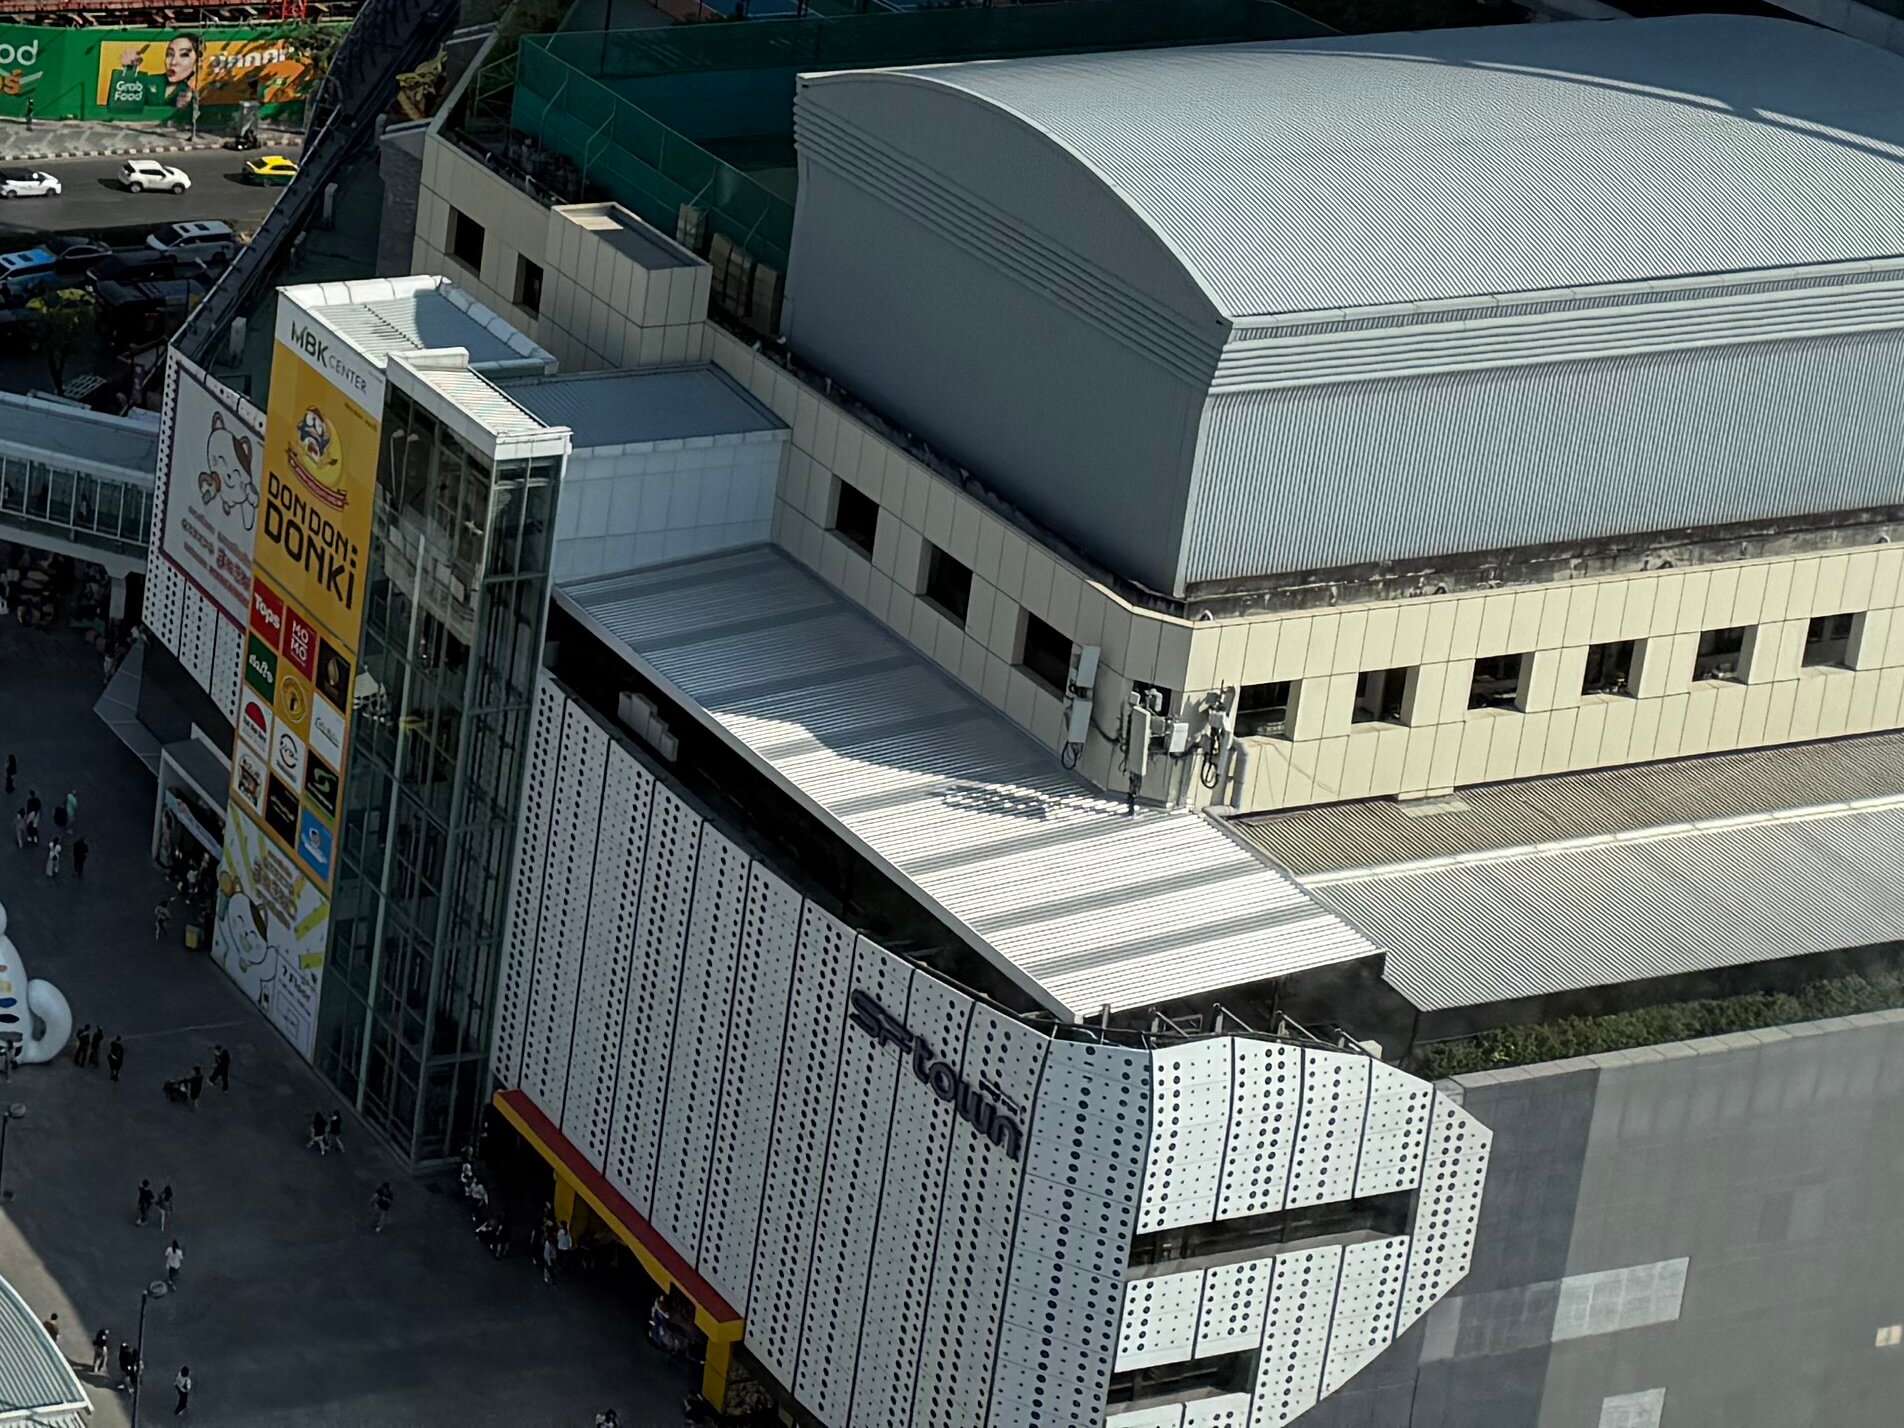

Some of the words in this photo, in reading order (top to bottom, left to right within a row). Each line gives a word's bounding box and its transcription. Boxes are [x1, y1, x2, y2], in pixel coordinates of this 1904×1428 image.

[114, 91, 143, 102] Food
[115, 80, 144, 92] Grab
[291, 320, 329, 368] MBK
[328, 355, 367, 394] CENTER
[268, 471, 307, 525] DON
[254, 592, 281, 629] Tops
